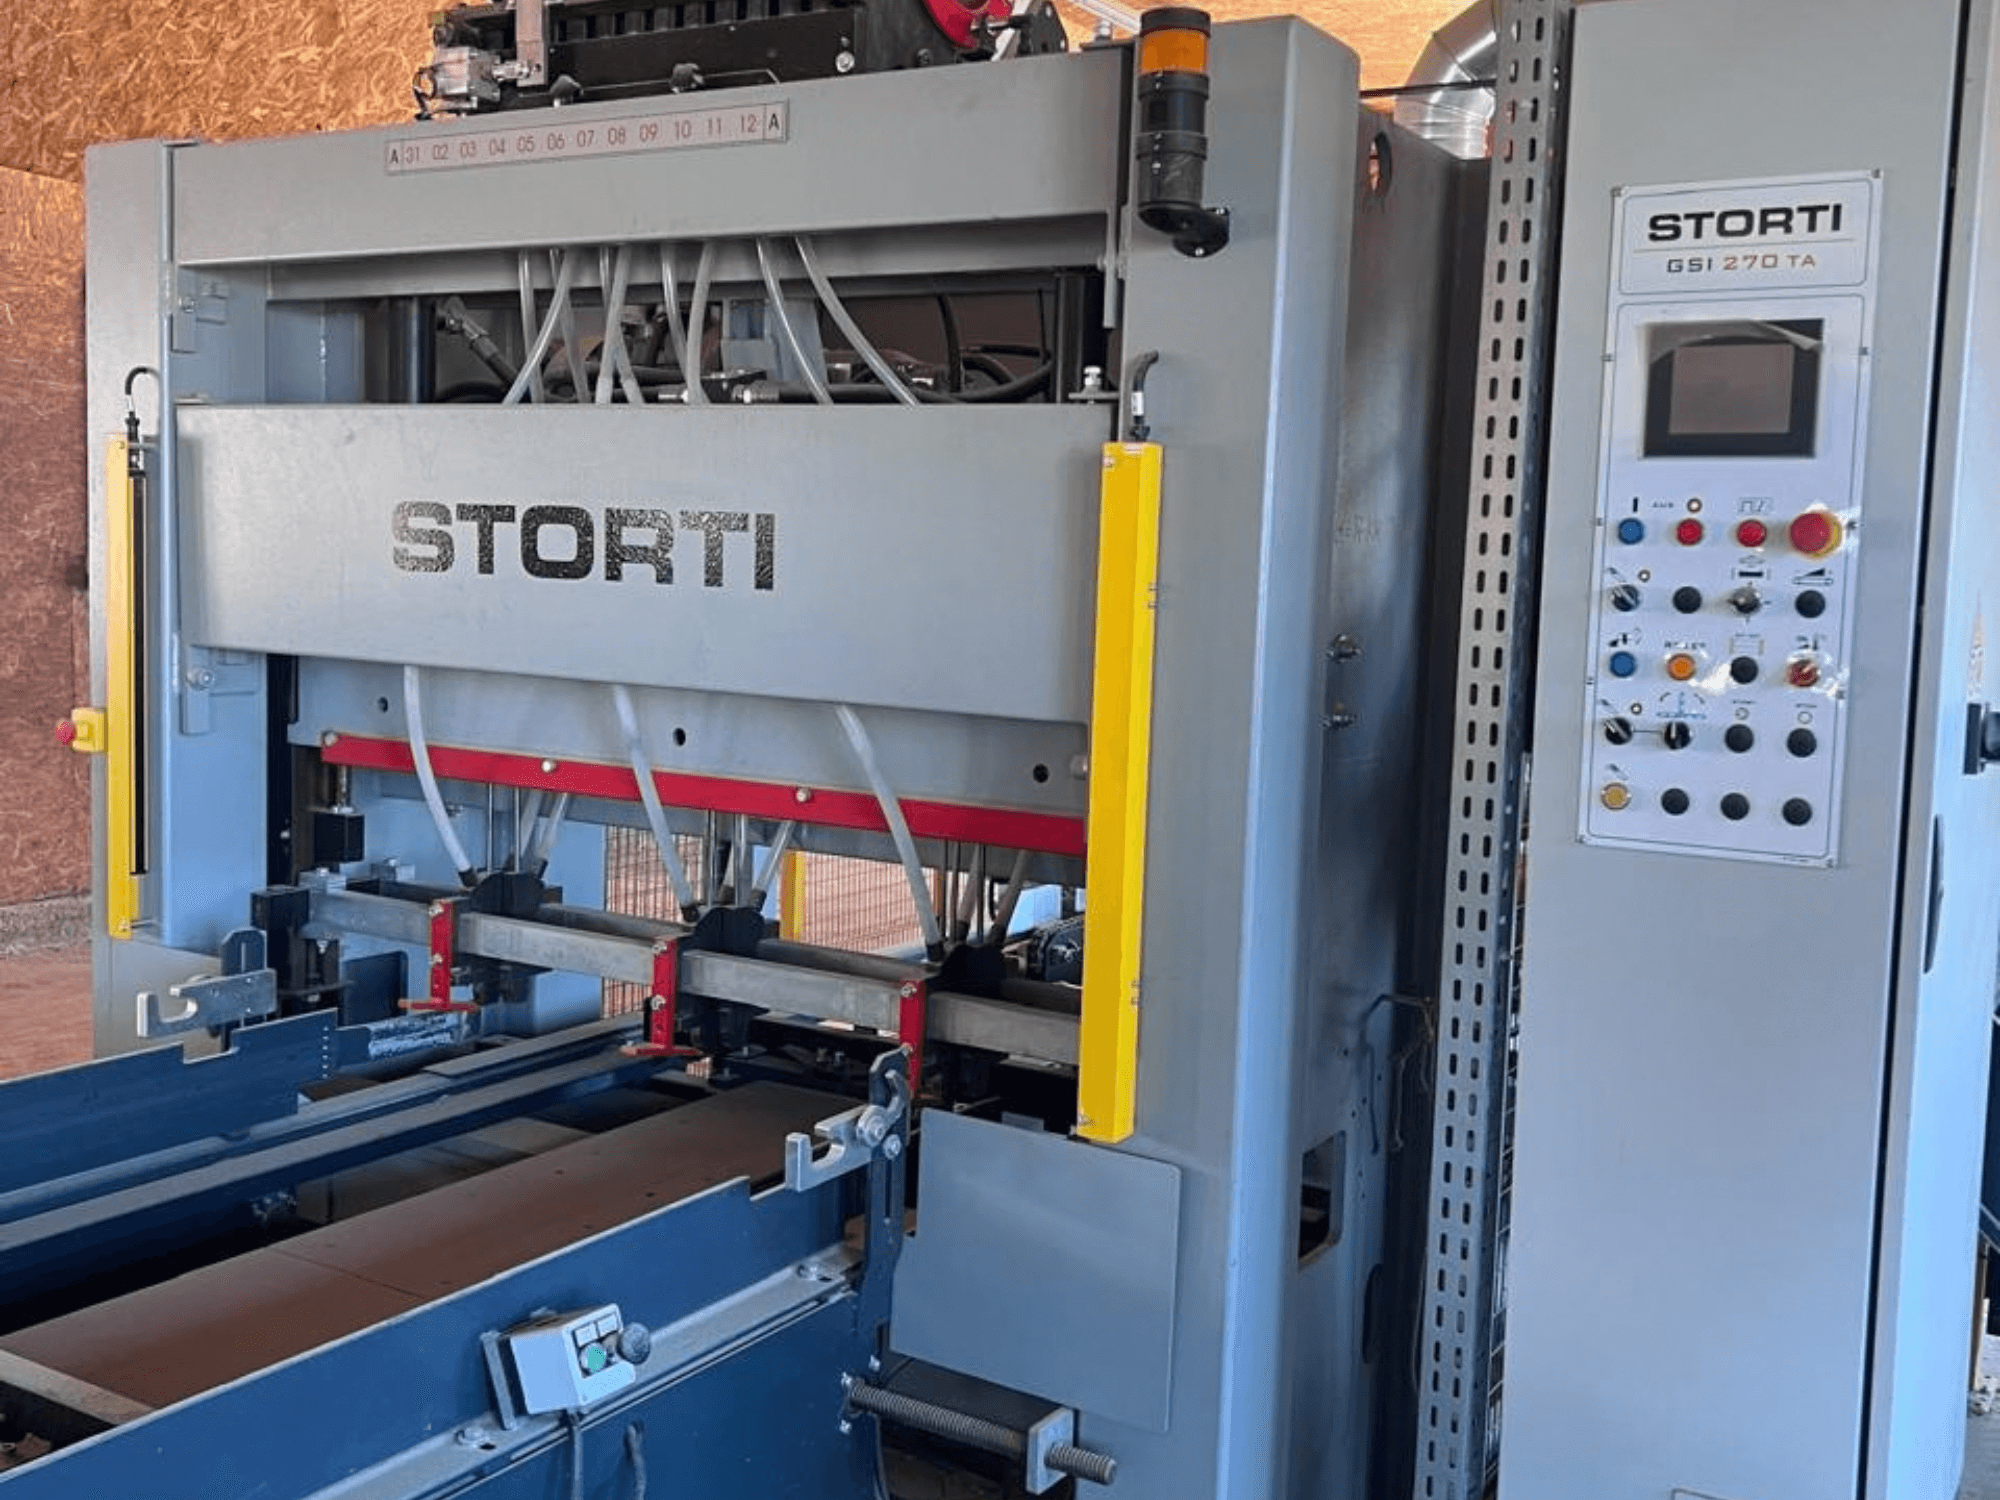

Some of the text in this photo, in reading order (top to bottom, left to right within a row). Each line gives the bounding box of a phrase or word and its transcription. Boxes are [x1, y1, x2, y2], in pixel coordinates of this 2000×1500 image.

[389, 148, 399, 164] A
[432, 144, 449, 160] 02
[460, 141, 477, 158] 03
[489, 138, 506, 155] 04
[516, 135, 535, 153] 05
[547, 132, 565, 150] 06
[577, 129, 594, 148] 07
[608, 126, 626, 145] 08
[639, 123, 658, 143] 09
[674, 119, 692, 141] 10
[707, 117, 721, 137] 11
[741, 112, 757, 133] 12
[768, 112, 780, 131] A
[1648, 203, 1842, 242] STORTI
[1666, 253, 1817, 273] GSI 270 TA
[391, 501, 775, 591] STORTI
